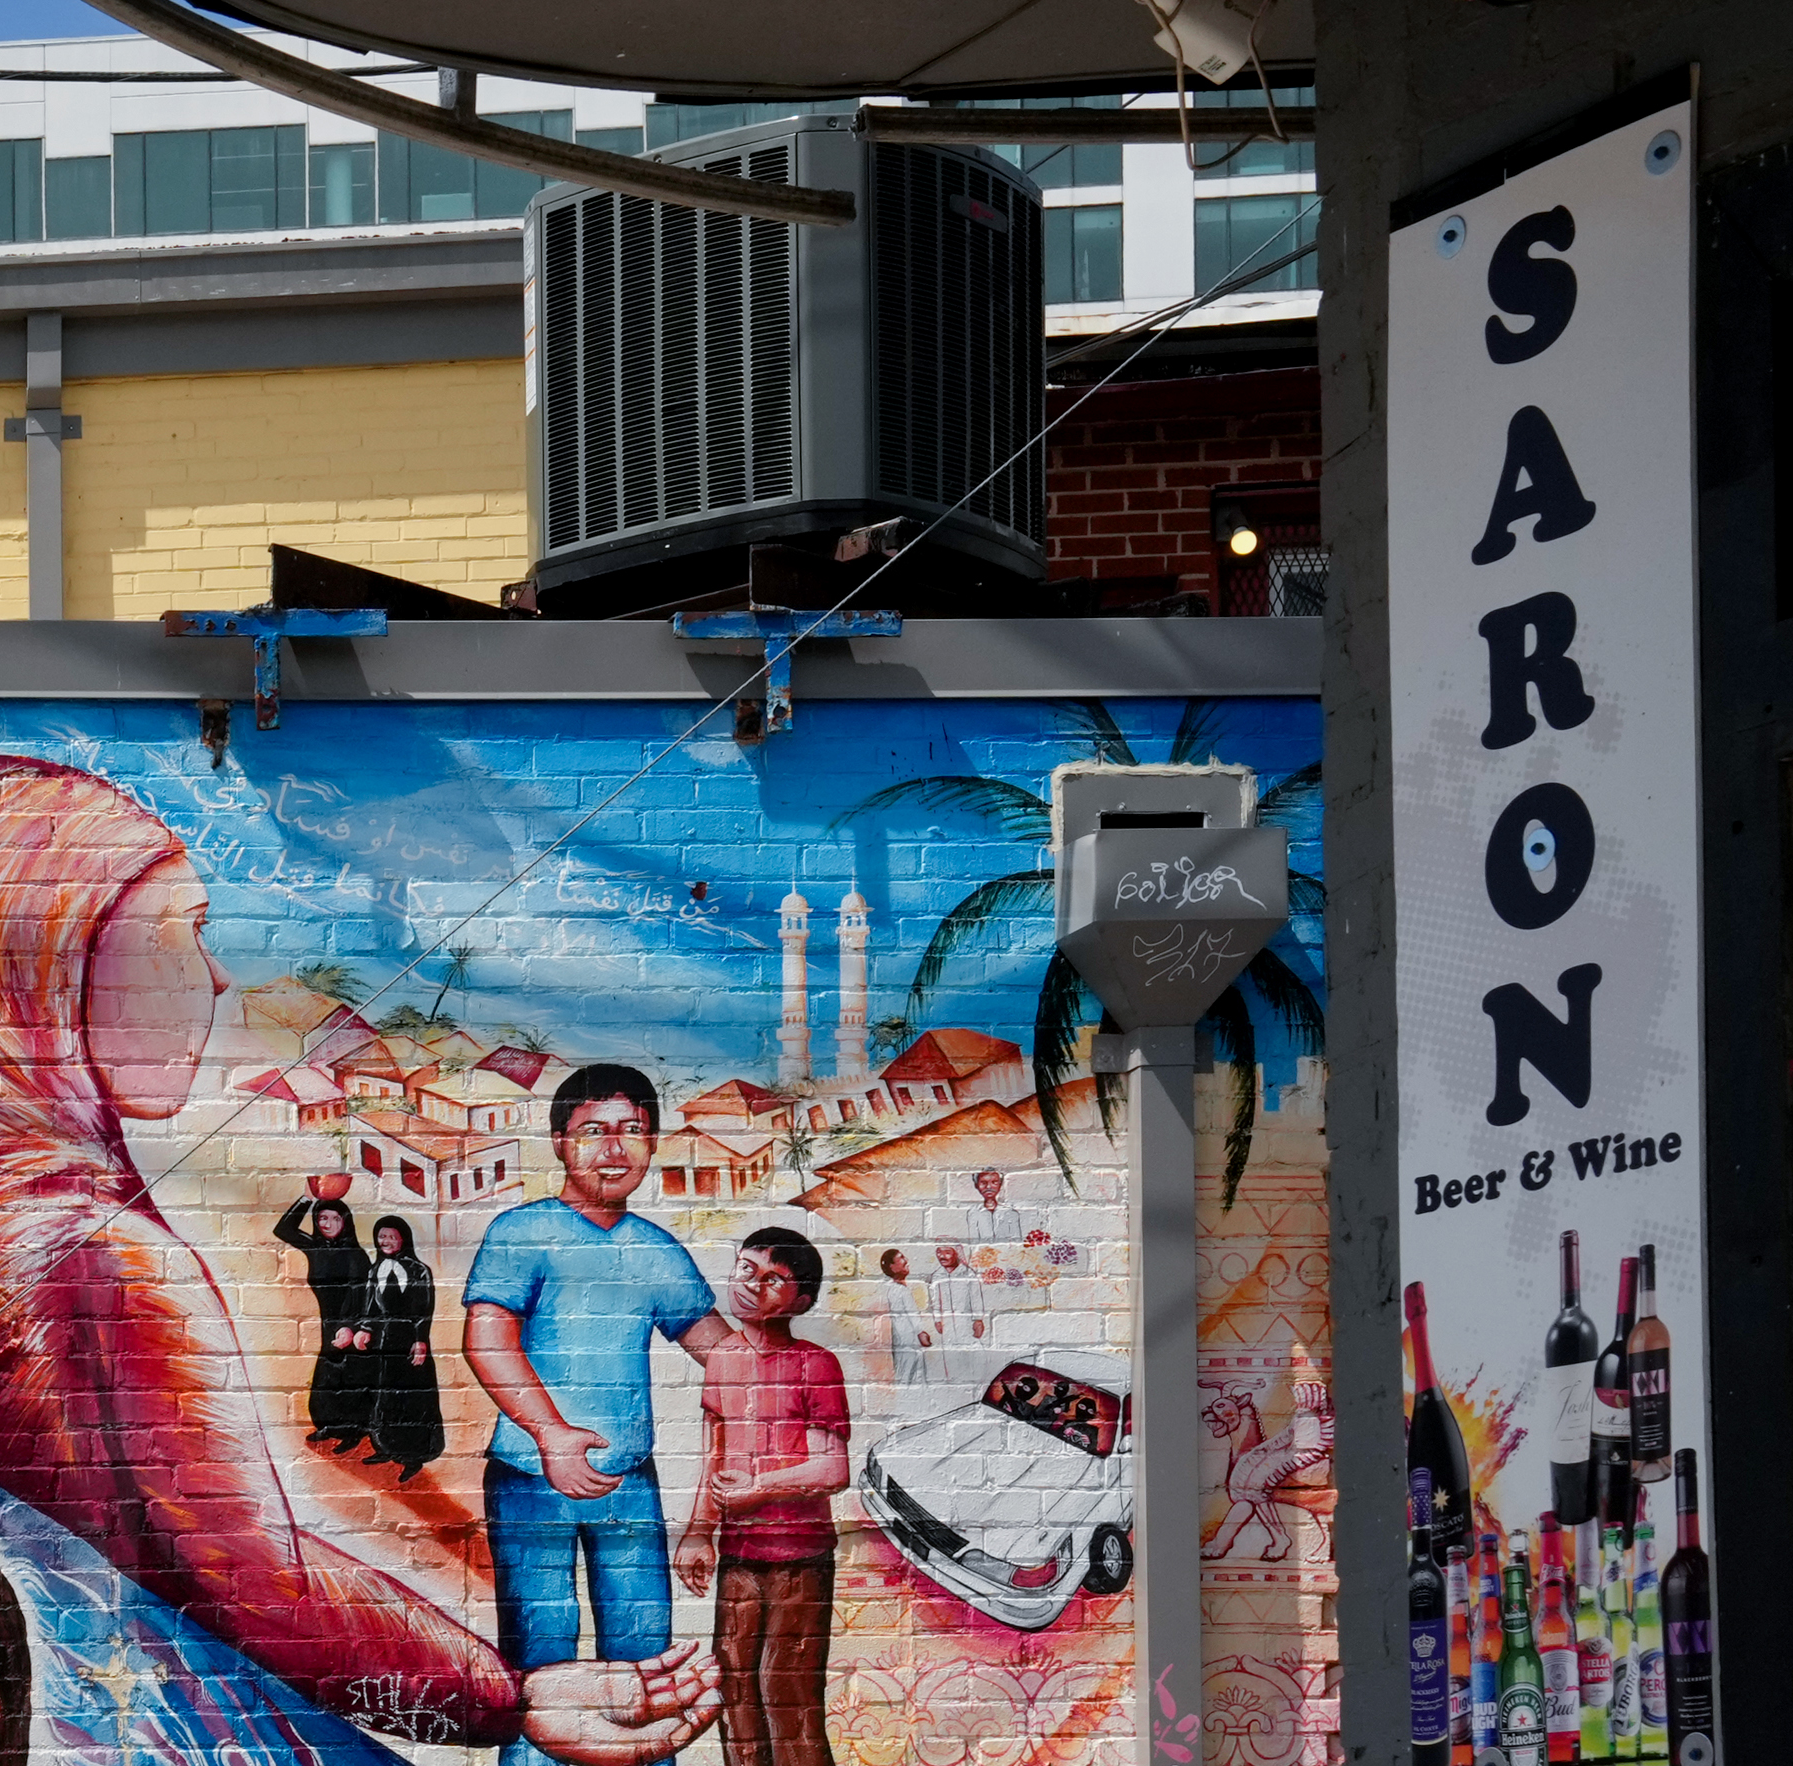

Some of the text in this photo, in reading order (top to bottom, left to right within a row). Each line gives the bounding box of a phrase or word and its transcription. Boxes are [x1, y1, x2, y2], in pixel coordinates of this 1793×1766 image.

[1471, 204, 1603, 1127] SARON
[1414, 1126, 1683, 1216] Beer & Wine
[1582, 1653, 1610, 1668] STELLA
[1545, 1696, 1577, 1719] Bud
[1502, 1731, 1544, 1746] Heineken
